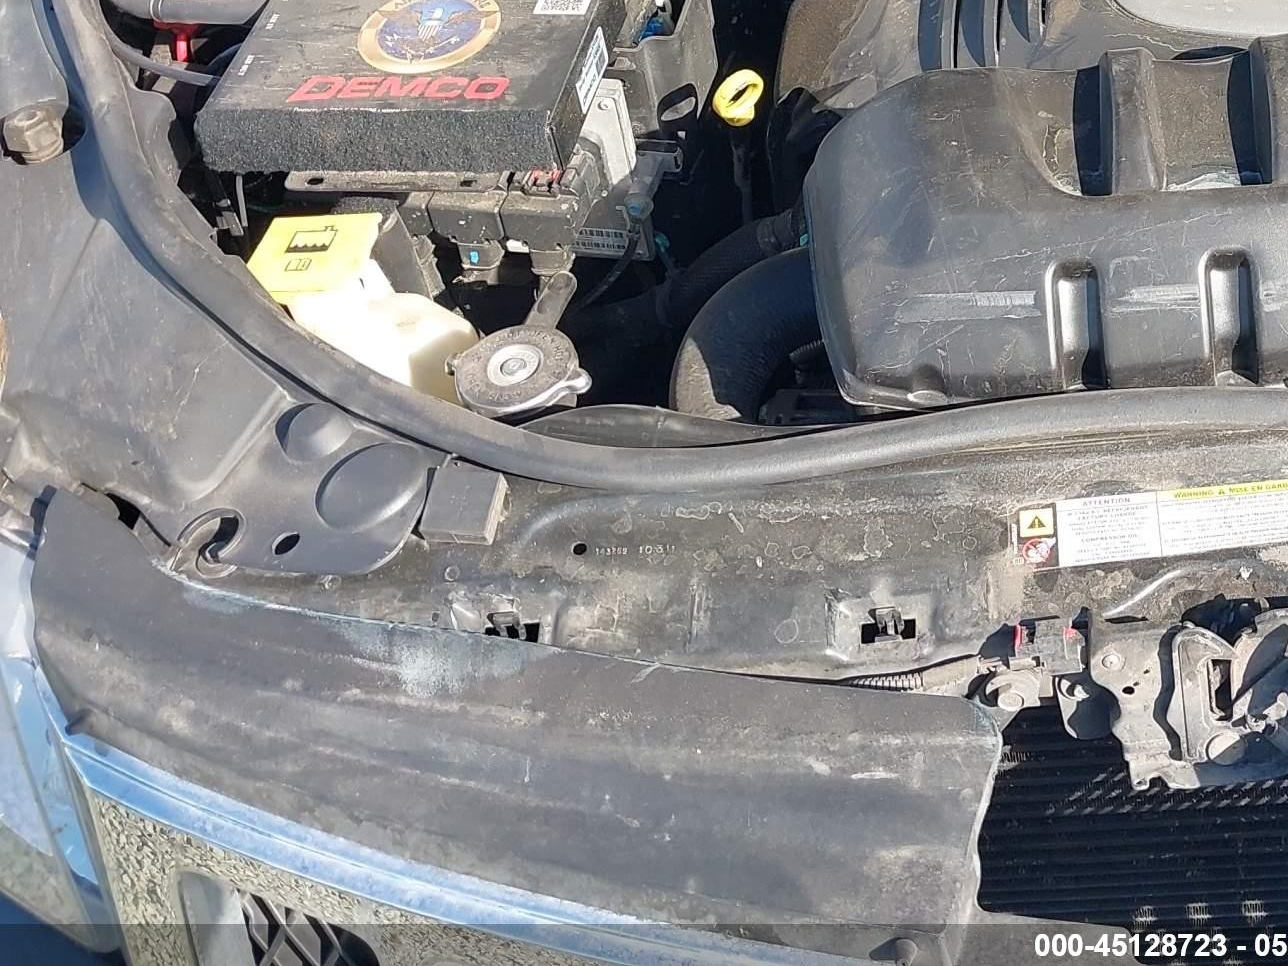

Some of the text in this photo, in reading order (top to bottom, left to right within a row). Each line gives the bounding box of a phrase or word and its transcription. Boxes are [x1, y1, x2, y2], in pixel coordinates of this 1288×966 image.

[286, 74, 511, 103] DEMCO
[1173, 489, 1214, 499] WARNING
[1083, 497, 1131, 507] ATTENTION
